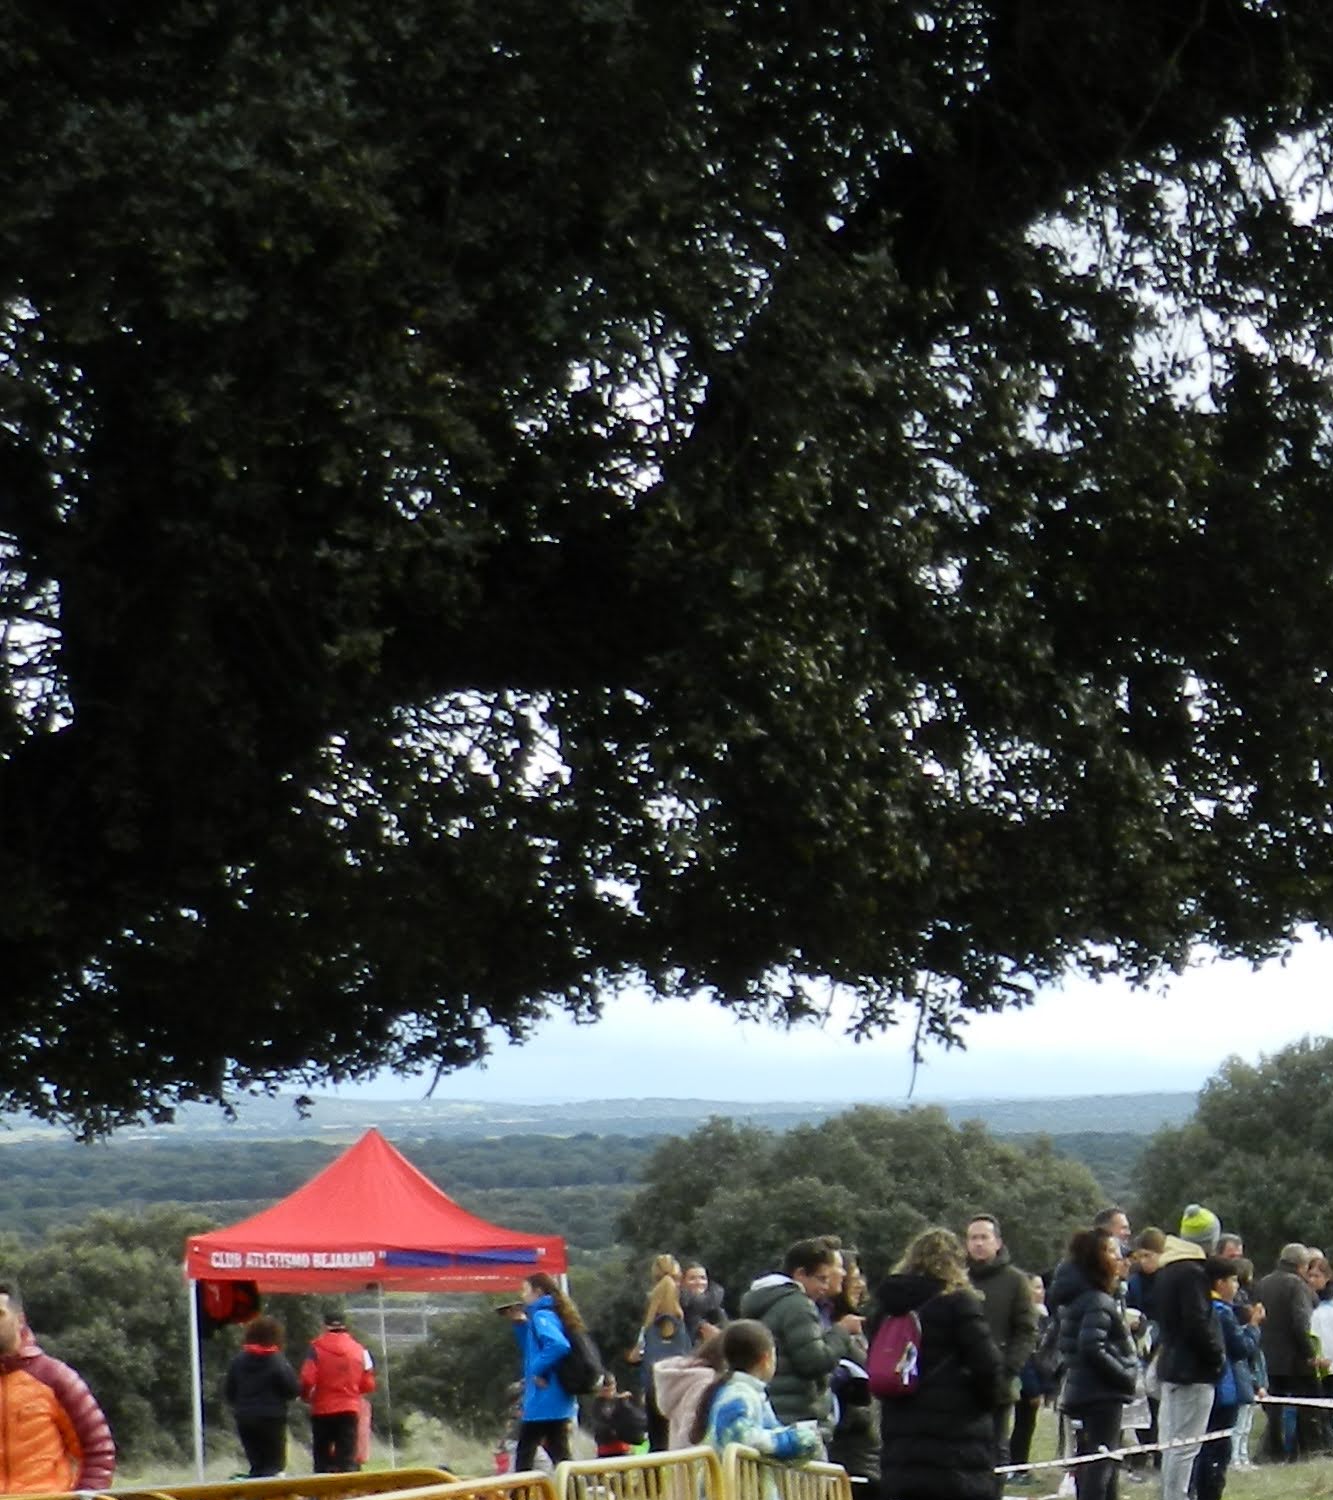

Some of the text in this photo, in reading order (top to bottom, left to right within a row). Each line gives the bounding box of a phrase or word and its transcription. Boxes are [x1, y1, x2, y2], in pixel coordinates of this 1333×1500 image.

[211, 1250, 376, 1269] CLUB ATLETISMO BEJARANO
